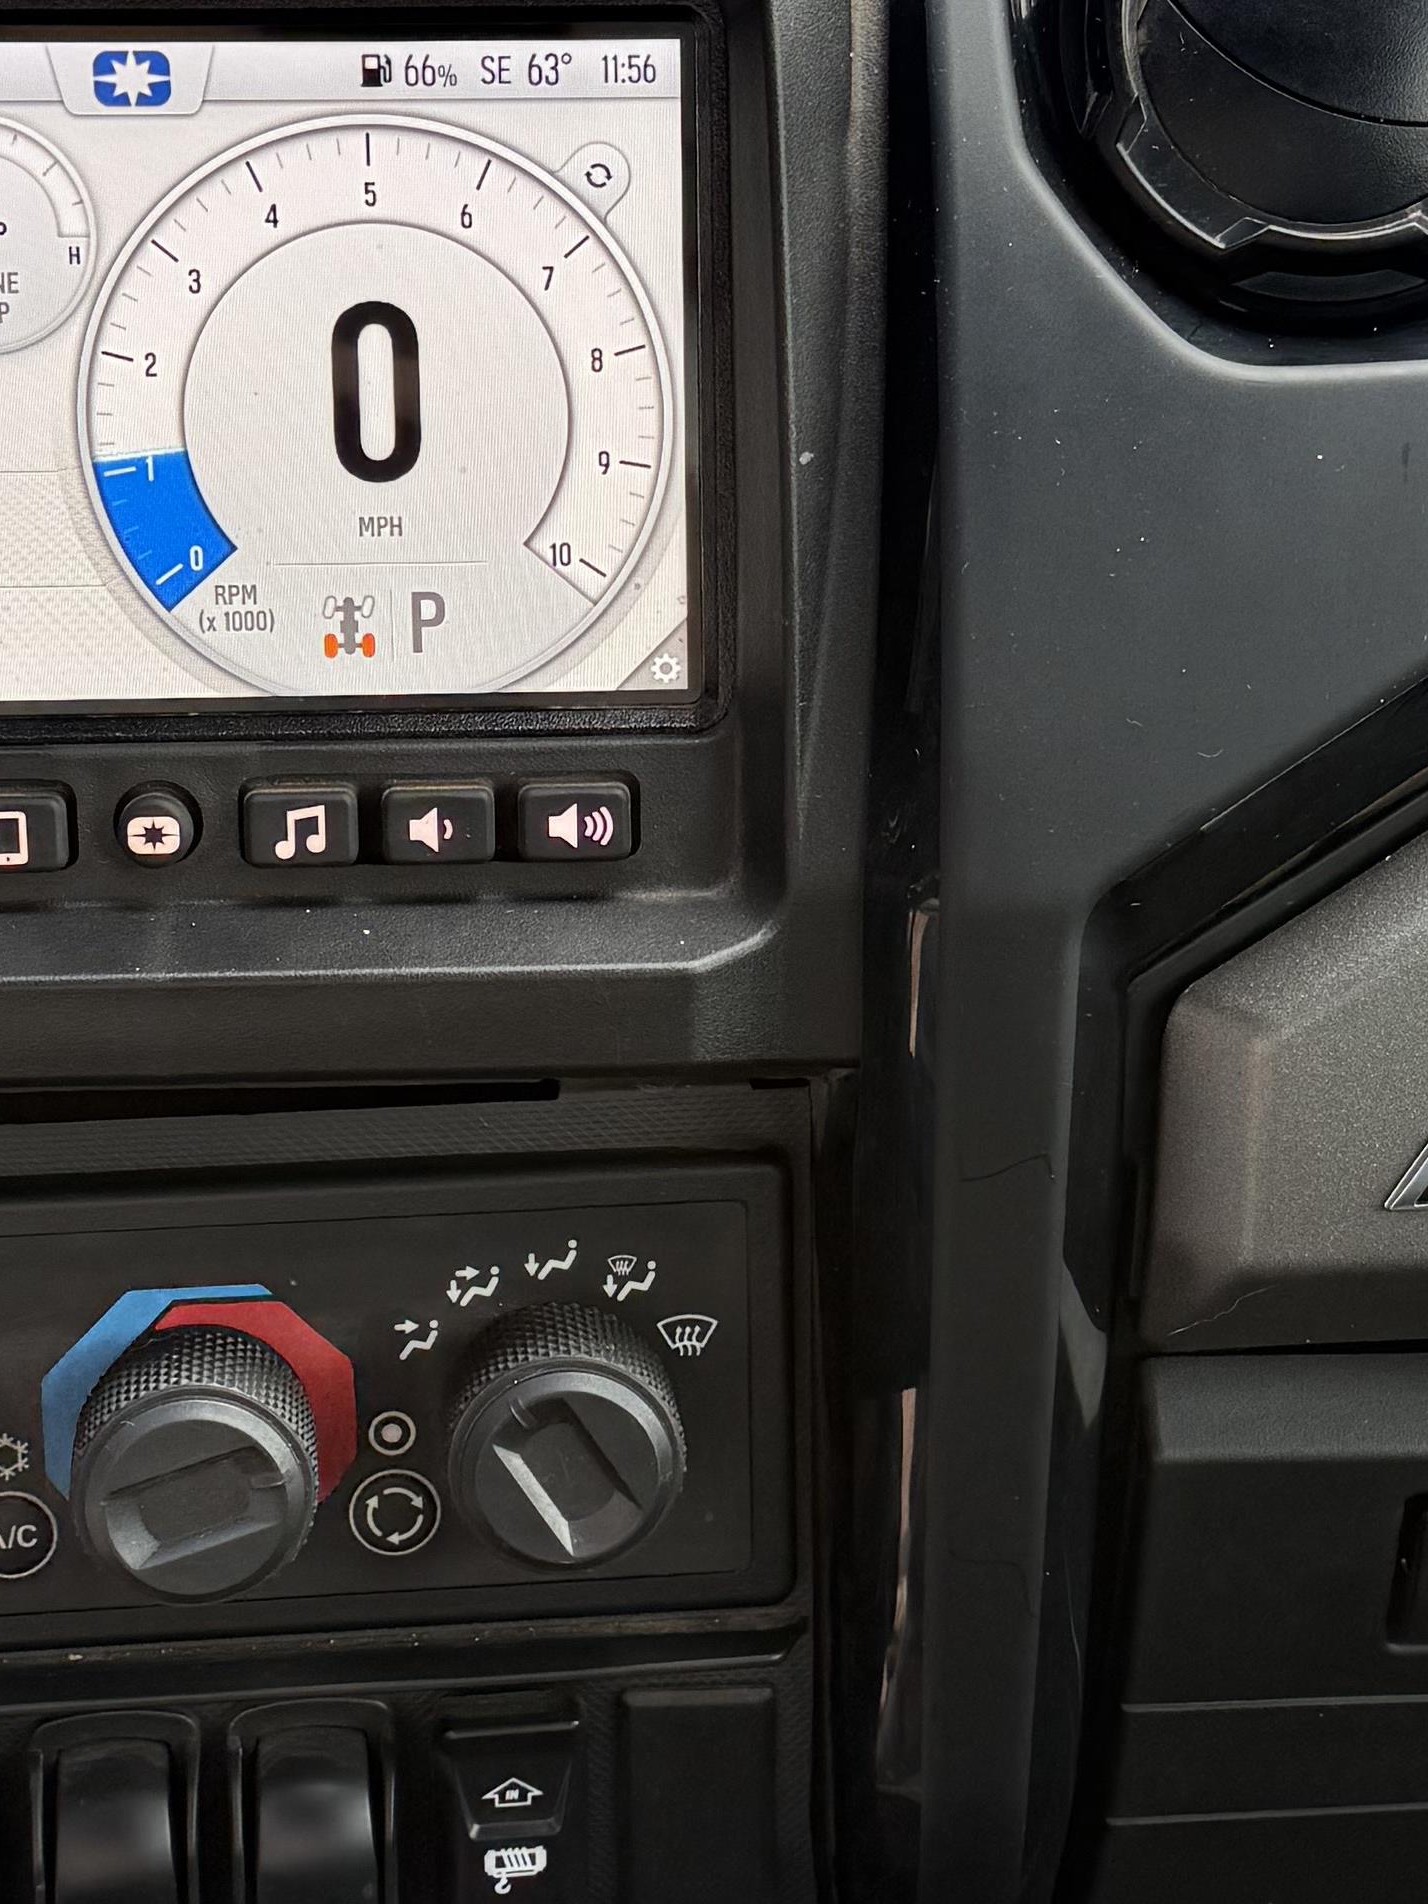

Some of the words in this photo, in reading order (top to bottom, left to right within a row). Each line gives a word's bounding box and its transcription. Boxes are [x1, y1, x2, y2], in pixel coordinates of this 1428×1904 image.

[404, 54, 458, 88] 66%
[480, 55, 512, 85] SE
[527, 52, 573, 86] 63°
[602, 54, 656, 84] 11:56
[364, 181, 377, 207] 5
[264, 203, 279, 229] 4
[460, 203, 473, 229] 6
[68, 245, 81, 265] H
[188, 268, 202, 294] 3
[541, 265, 555, 291] 7
[144, 352, 158, 378] 2
[590, 347, 603, 373] 8
[330, 300, 422, 484] 0
[144, 455, 155, 481] 1
[598, 450, 611, 475] 9
[358, 515, 403, 538] MPH
[189, 545, 204, 572] 0
[548, 542, 572, 570] 10
[214, 584, 257, 606] RPM
[198, 609, 217, 634] (x
[223, 608, 275, 633] 1000)
[411, 591, 446, 654] P
[505, 1788, 520, 1802] IN
